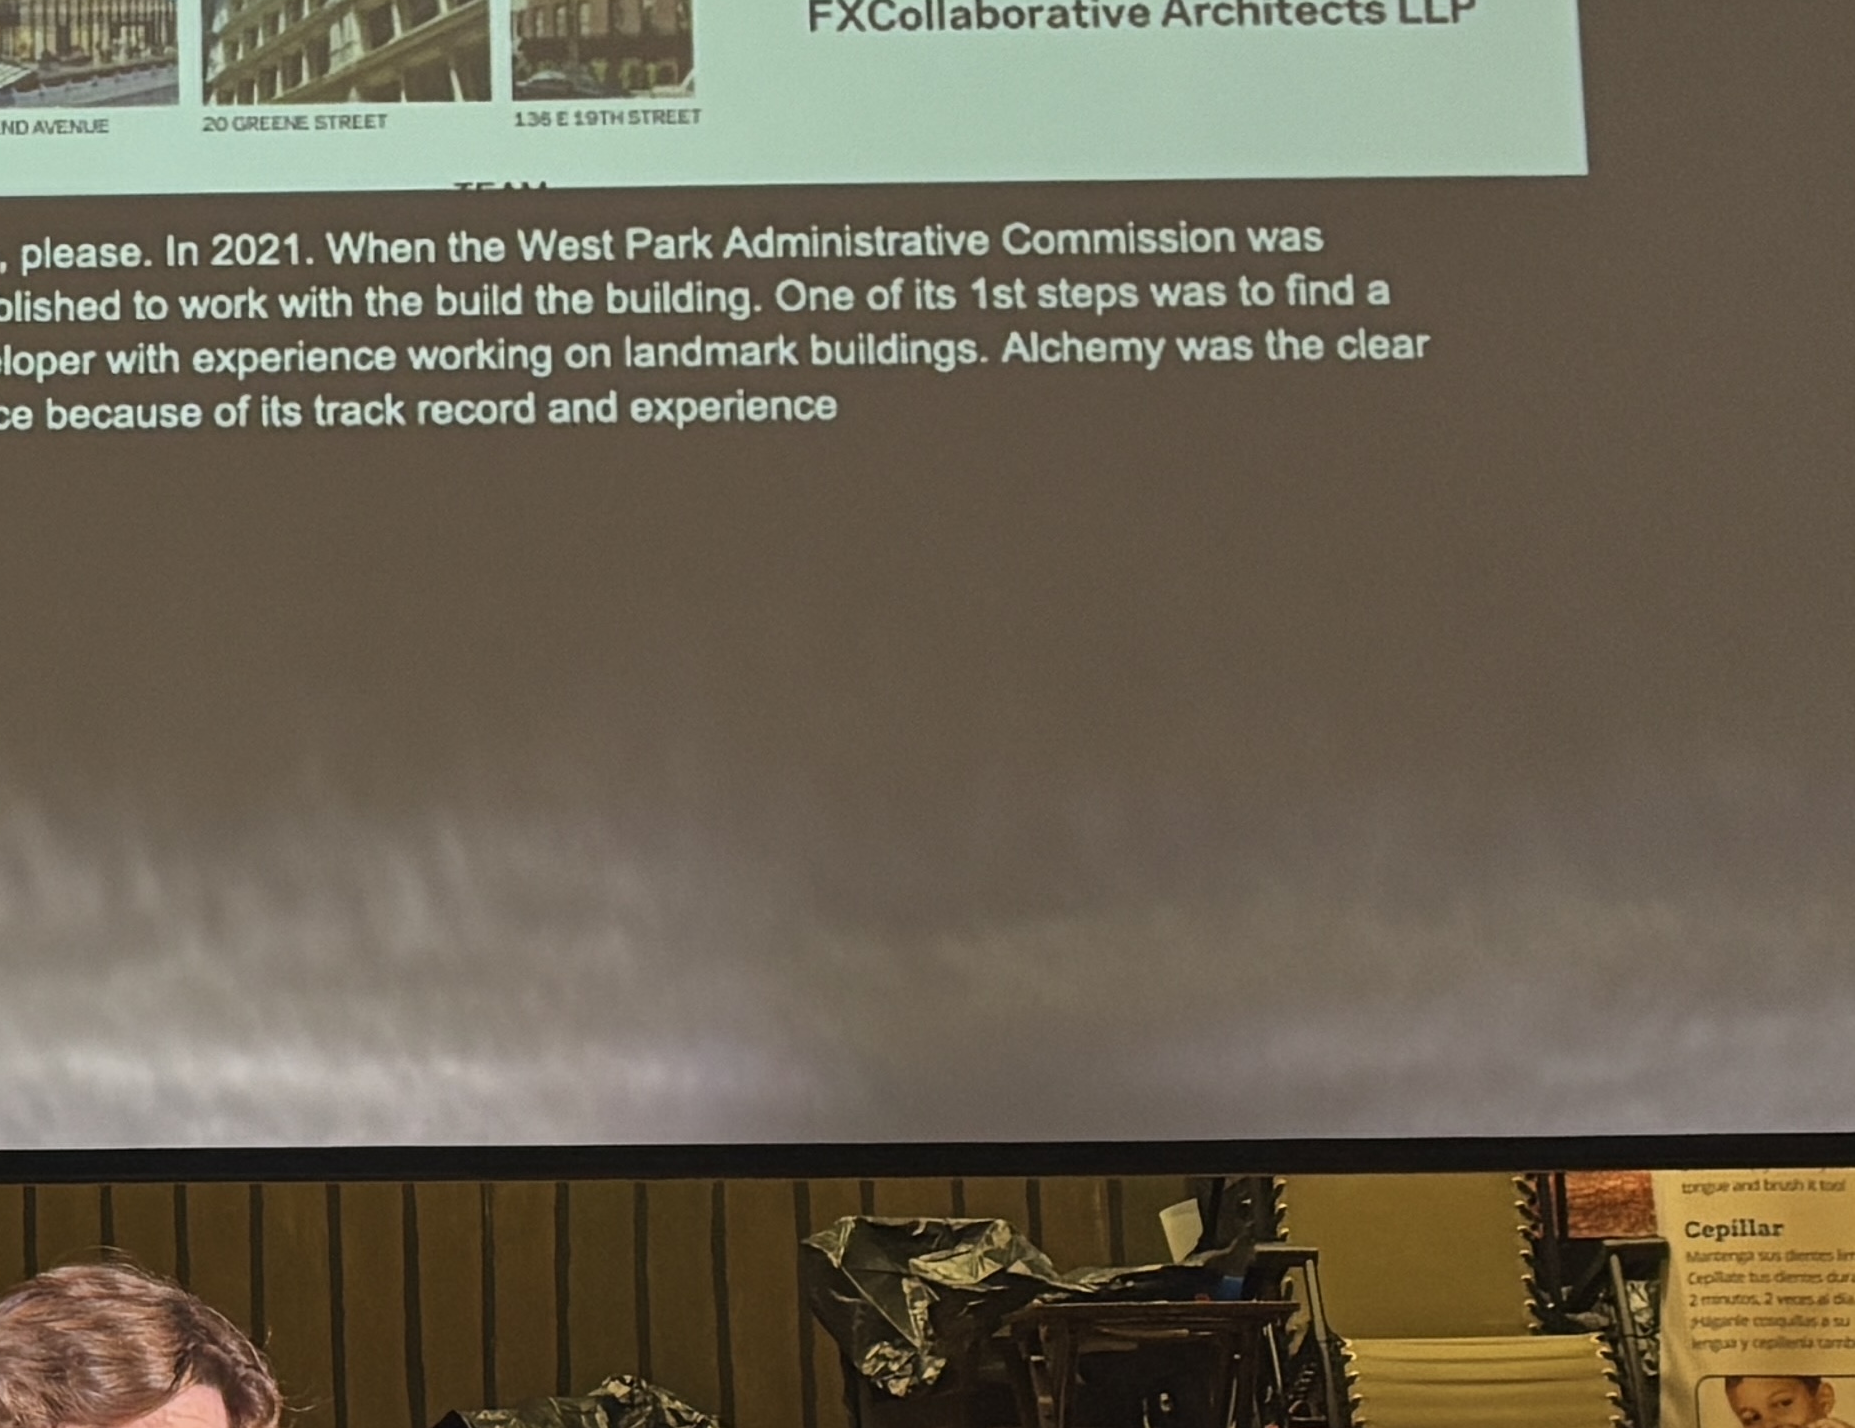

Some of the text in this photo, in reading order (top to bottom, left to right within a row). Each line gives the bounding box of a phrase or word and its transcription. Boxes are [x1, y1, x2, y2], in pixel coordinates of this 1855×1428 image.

[32, 118, 110, 136] AVENUE
[201, 116, 229, 133] 20
[314, 113, 388, 131] STREET
[555, 110, 569, 127] E
[573, 109, 625, 127] 19TH
[627, 107, 702, 126] STREET
[20, 236, 153, 277] please.
[166, 234, 199, 267] In
[210, 232, 314, 266] 2021.
[325, 231, 436, 265] When
[447, 230, 506, 263] the
[516, 228, 616, 262] West
[625, 226, 714, 261] Park
[722, 223, 990, 259] Administrative
[1001, 220, 1236, 255] Commission
[1246, 226, 1325, 253] was
[132, 289, 169, 321] to
[178, 286, 269, 320] work
[277, 285, 353, 319] with
[364, 284, 424, 318] the
[436, 282, 523, 316] build
[534, 282, 594, 316] the
[606, 280, 762, 320] building.
[774, 278, 855, 312] One
[865, 276, 905, 311] of
[914, 277, 957, 310] its
[970, 276, 1028, 310] 1st
[1037, 277, 1140, 317] steps
[1149, 281, 1228, 308] was
[1238, 275, 1275, 307] to
[1285, 272, 1355, 306] find
[1366, 279, 1391, 305] a
[105, 341, 180, 375] with
[192, 339, 397, 379] experience
[406, 337, 553, 378] working
[564, 342, 612, 369] on
[624, 333, 800, 368] landmark
[810, 332, 989, 372] buildings.
[1001, 330, 1167, 370] Alchemy
[1175, 335, 1254, 362] was
[1264, 327, 1325, 361] the
[1336, 327, 1431, 361] clear
[45, 397, 203, 430] because
[213, 393, 252, 428] of
[261, 394, 303, 428] its
[313, 392, 407, 427] track
[417, 391, 536, 425] record
[547, 389, 618, 424] and
[630, 388, 838, 429] experience
[1733, 1179, 1760, 1192] and
[1684, 1218, 1785, 1242] Cepillar
[1764, 1292, 1773, 1305] 2
